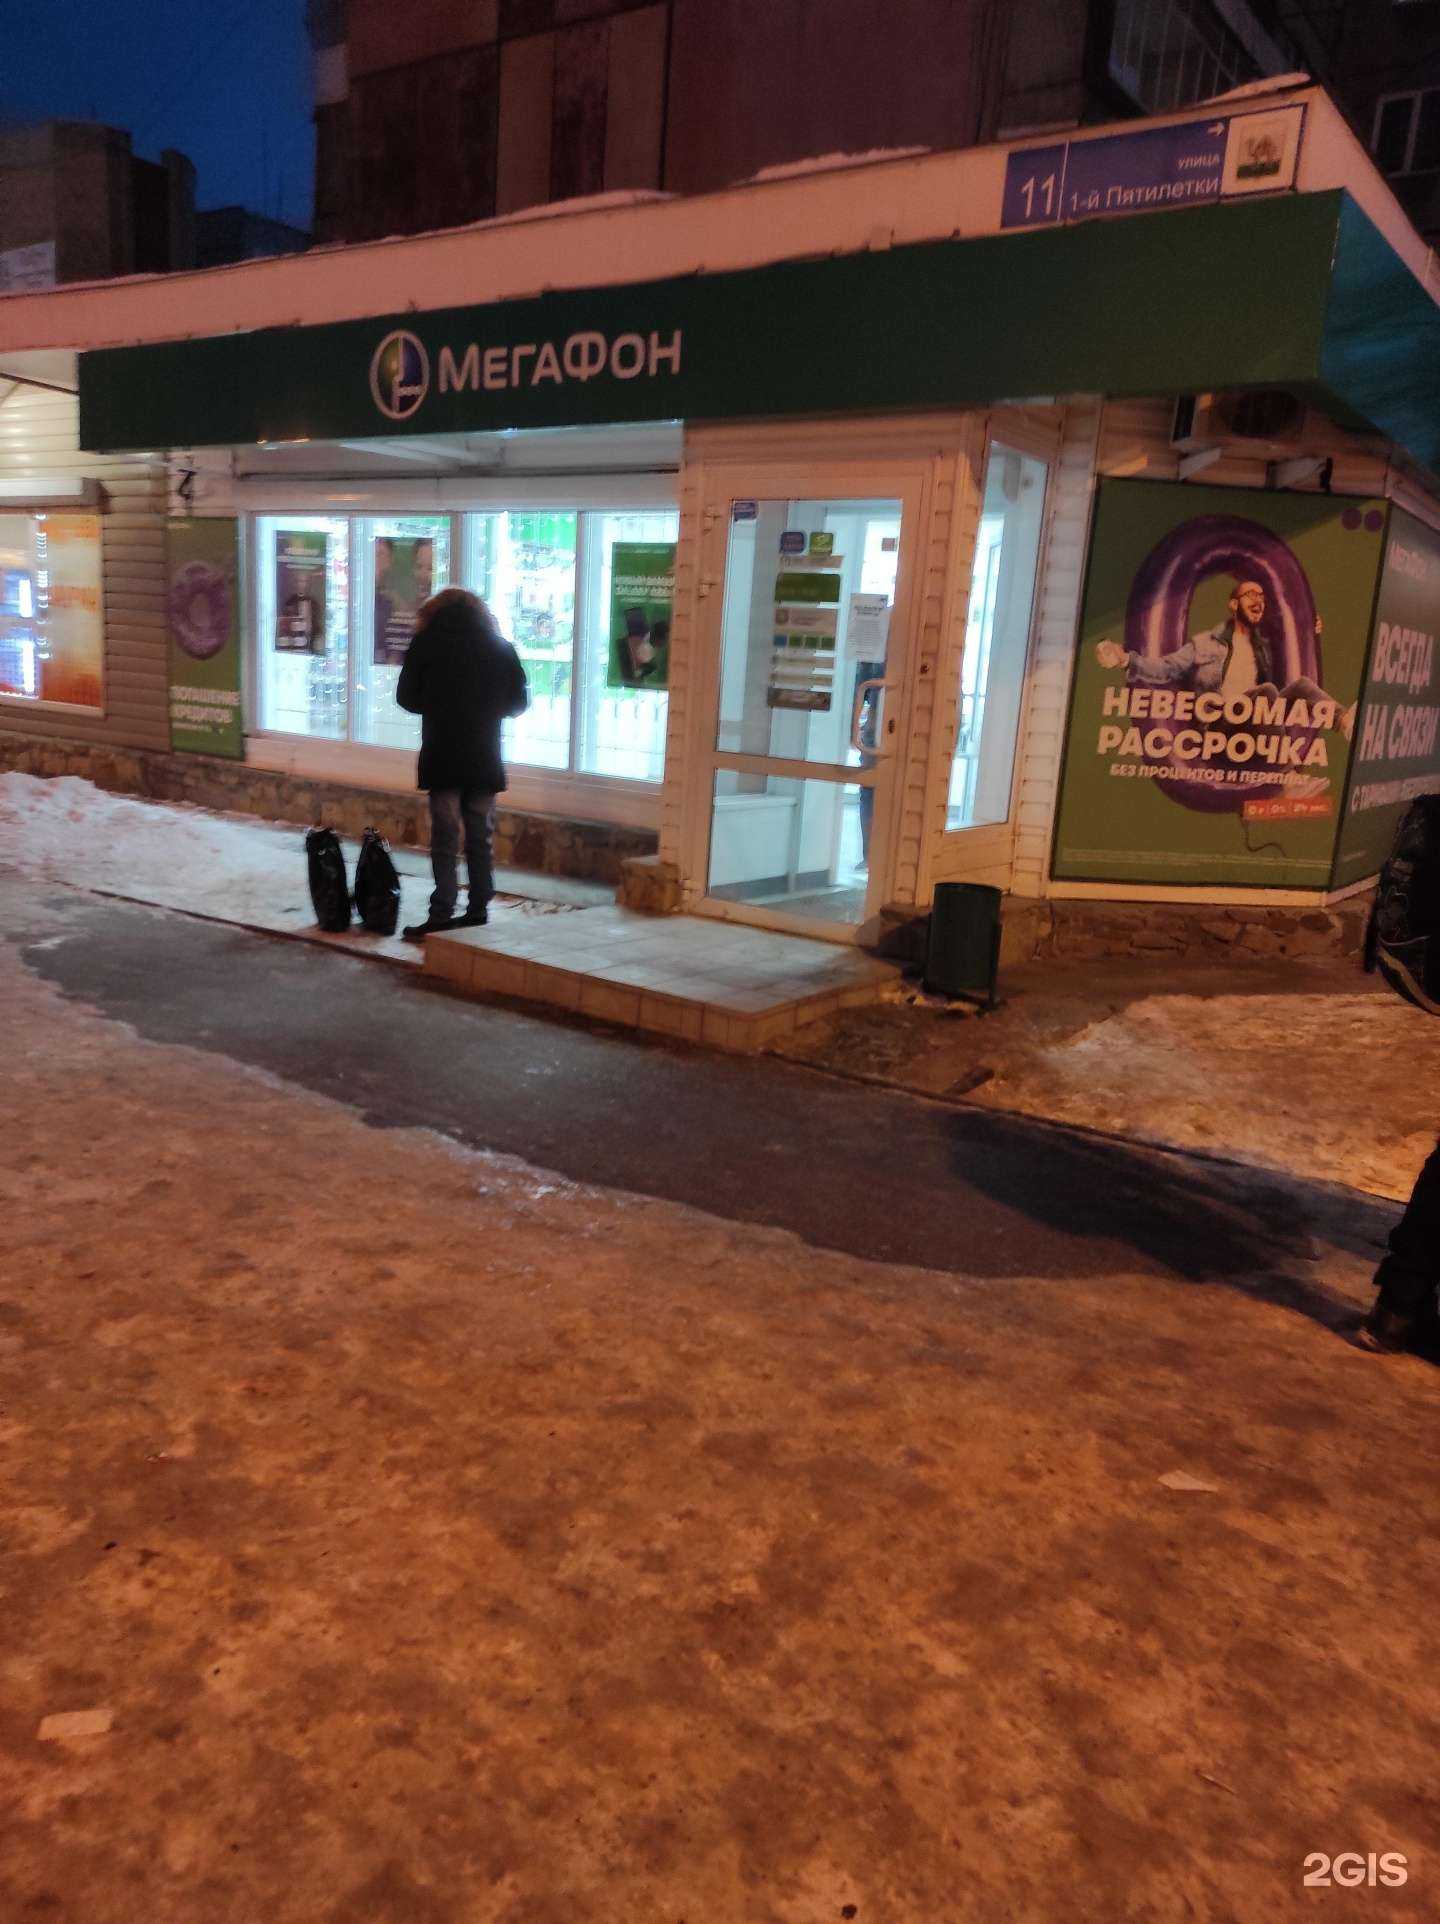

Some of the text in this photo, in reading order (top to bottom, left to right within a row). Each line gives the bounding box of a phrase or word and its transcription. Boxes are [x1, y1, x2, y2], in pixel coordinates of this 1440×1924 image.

[1020, 172, 1057, 219] 11
[1070, 177, 1219, 212] 1-й Пятилетки
[1371, 621, 1434, 695] ВСЕГДА
[1102, 686, 1336, 730] НЕВЕСОМАЯ
[1097, 725, 1329, 767] РАССРОЧКА
[1359, 704, 1388, 762] НА
[1110, 764, 1136, 777] БЕЗ
